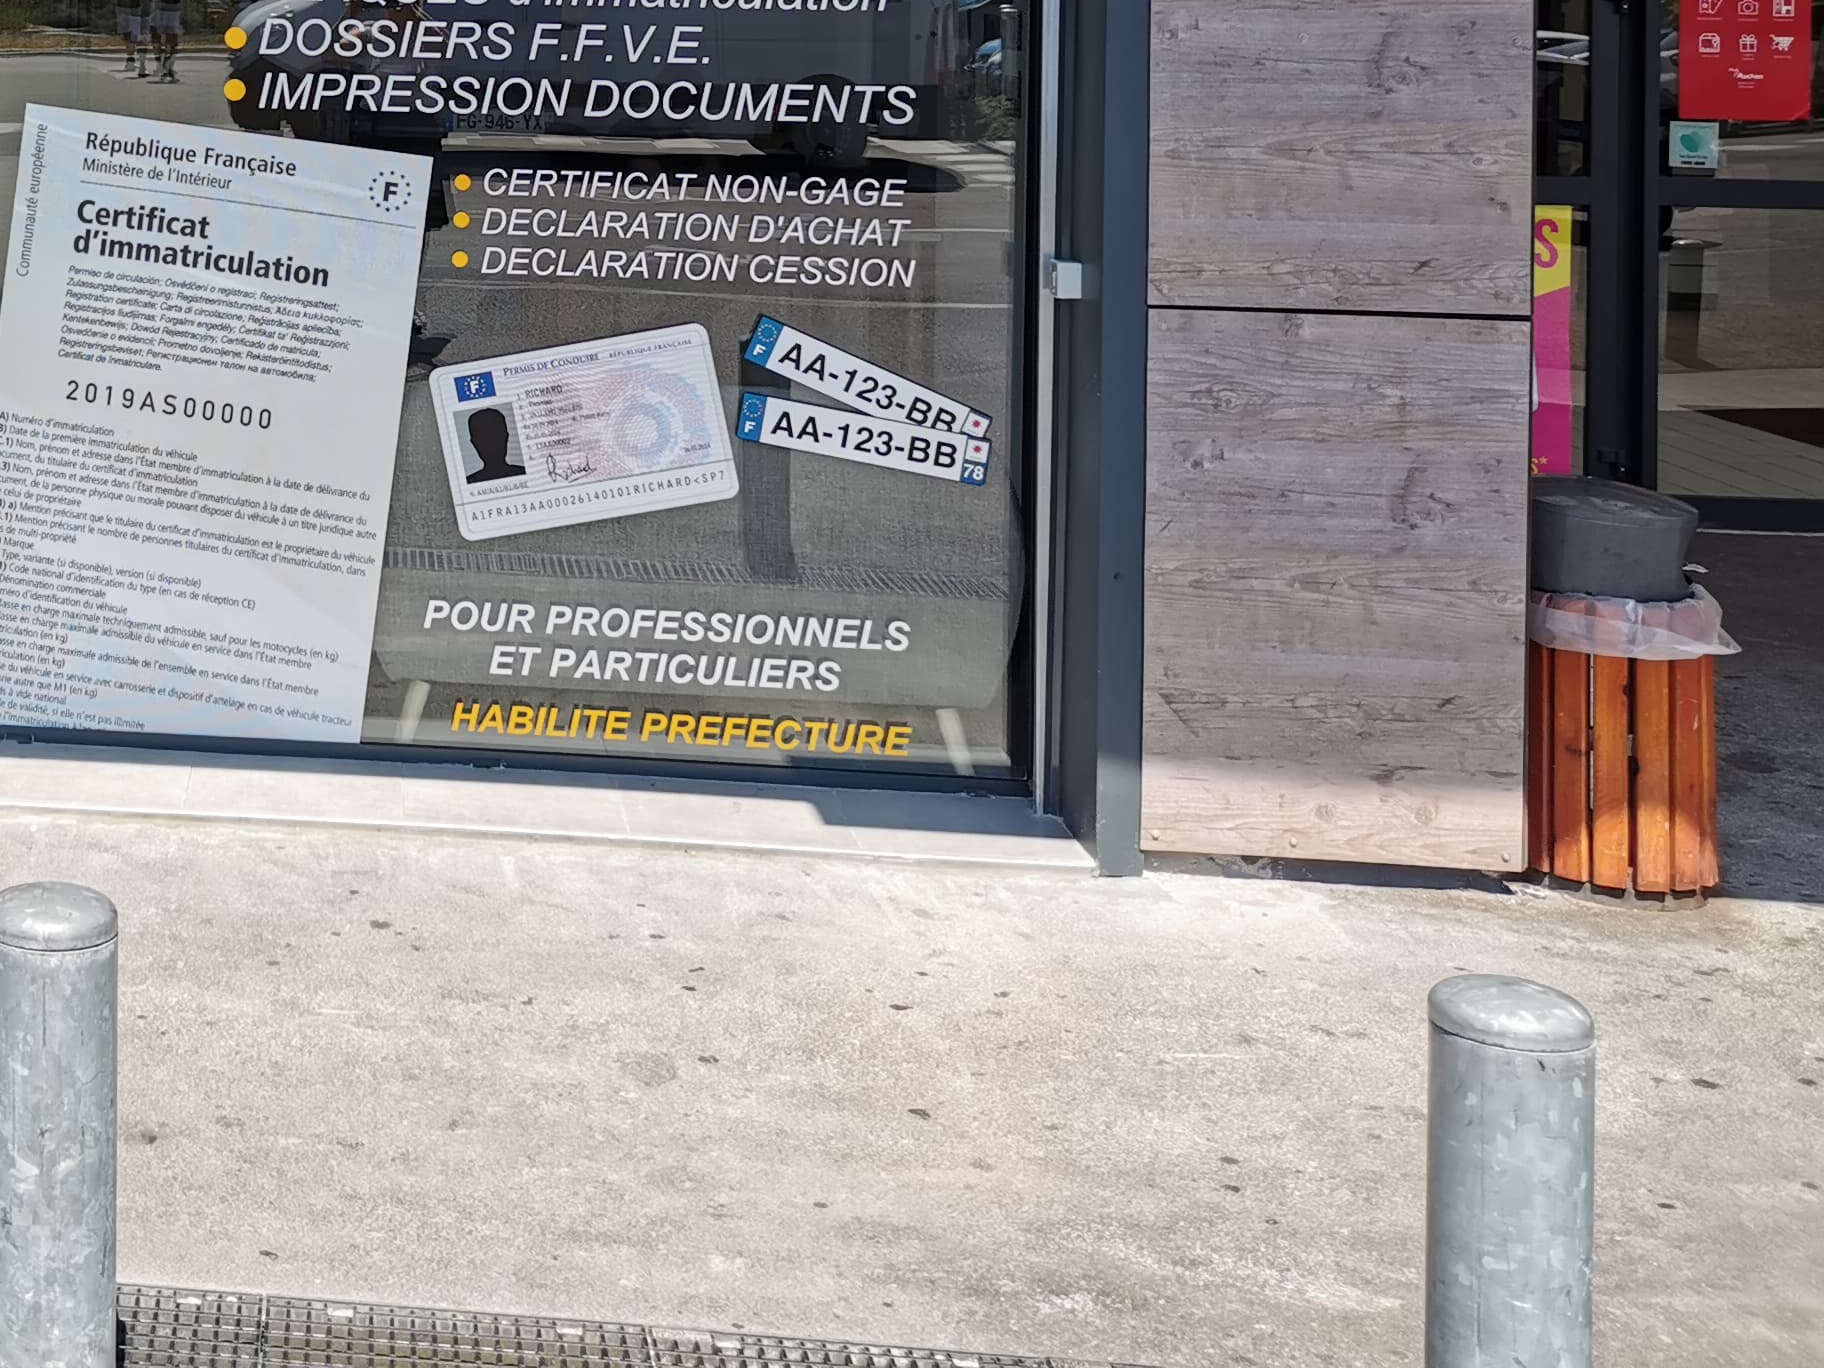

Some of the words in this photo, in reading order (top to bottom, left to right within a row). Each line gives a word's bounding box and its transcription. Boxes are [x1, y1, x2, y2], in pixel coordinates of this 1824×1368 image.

[258, 18, 515, 61] DOSSIERS
[529, 23, 710, 65] F.F.V.E.
[258, 72, 571, 117] IMPRESSION
[583, 79, 917, 125] DOCUMENTS
[82, 158, 143, 178] Ministère
[147, 165, 164, 181] de
[168, 167, 232, 190] l'Intérieur
[85, 132, 197, 164] République
[204, 147, 297, 177] Française
[16, 197, 39, 277] Communauté
[32, 123, 48, 194] européenne
[383, 182, 399, 202] F
[483, 168, 697, 201] CERTIFICAT
[704, 174, 908, 207] NON-GAGE
[77, 199, 210, 240] Certificat
[481, 208, 736, 242] DECLARATION
[748, 215, 911, 248] D'ACHAT
[73, 230, 329, 287] d'immatriculation
[481, 247, 736, 282] DECLARATION
[749, 254, 917, 288] CESSION
[64, 288, 114, 306] Registration
[753, 344, 767, 356] F
[66, 380, 272, 429] 2019AS00000
[470, 379, 480, 395] F
[778, 343, 957, 433] AA-123-BB
[8, 424, 28, 436] Date
[29, 427, 40, 438] de
[41, 429, 50, 439] la
[50, 430, 87, 447] première
[87, 435, 151, 454] immatriculation
[151, 445, 164, 456] du
[164, 447, 198, 461] véhicule
[10, 412, 44, 426] Numéro
[44, 416, 115, 436] d'immatriculation
[744, 421, 756, 433] F
[770, 411, 957, 469] AA-123-BB
[15, 438, 37, 452] Nom,
[38, 441, 70, 457] prénom
[71, 447, 80, 457] et
[81, 447, 112, 462] adresse
[113, 452, 134, 465] dans
[134, 455, 157, 468] l'État
[157, 459, 192, 474] membre
[192, 464, 265, 484] d'immatriculation
[265, 475, 272, 486] à
[272, 476, 282, 487] la
[282, 478, 302, 490] date
[302, 481, 315, 492] de
[315, 482, 358, 498] délivrance
[358, 489, 371, 500] du
[33, 453, 46, 464] du
[46, 455, 78, 469] titulaire
[78, 459, 90, 471] du
[91, 461, 127, 476] certificat
[127, 466, 199, 486] d'immatriculation
[963, 463, 984, 481] 78
[423, 599, 536, 634] POUR
[545, 605, 911, 651] PROFESSIONNELS
[489, 645, 542, 676] ET
[549, 648, 842, 692] PARTICULIERS
[450, 701, 632, 741] HABILITE
[640, 712, 913, 757] PREFECTURE
